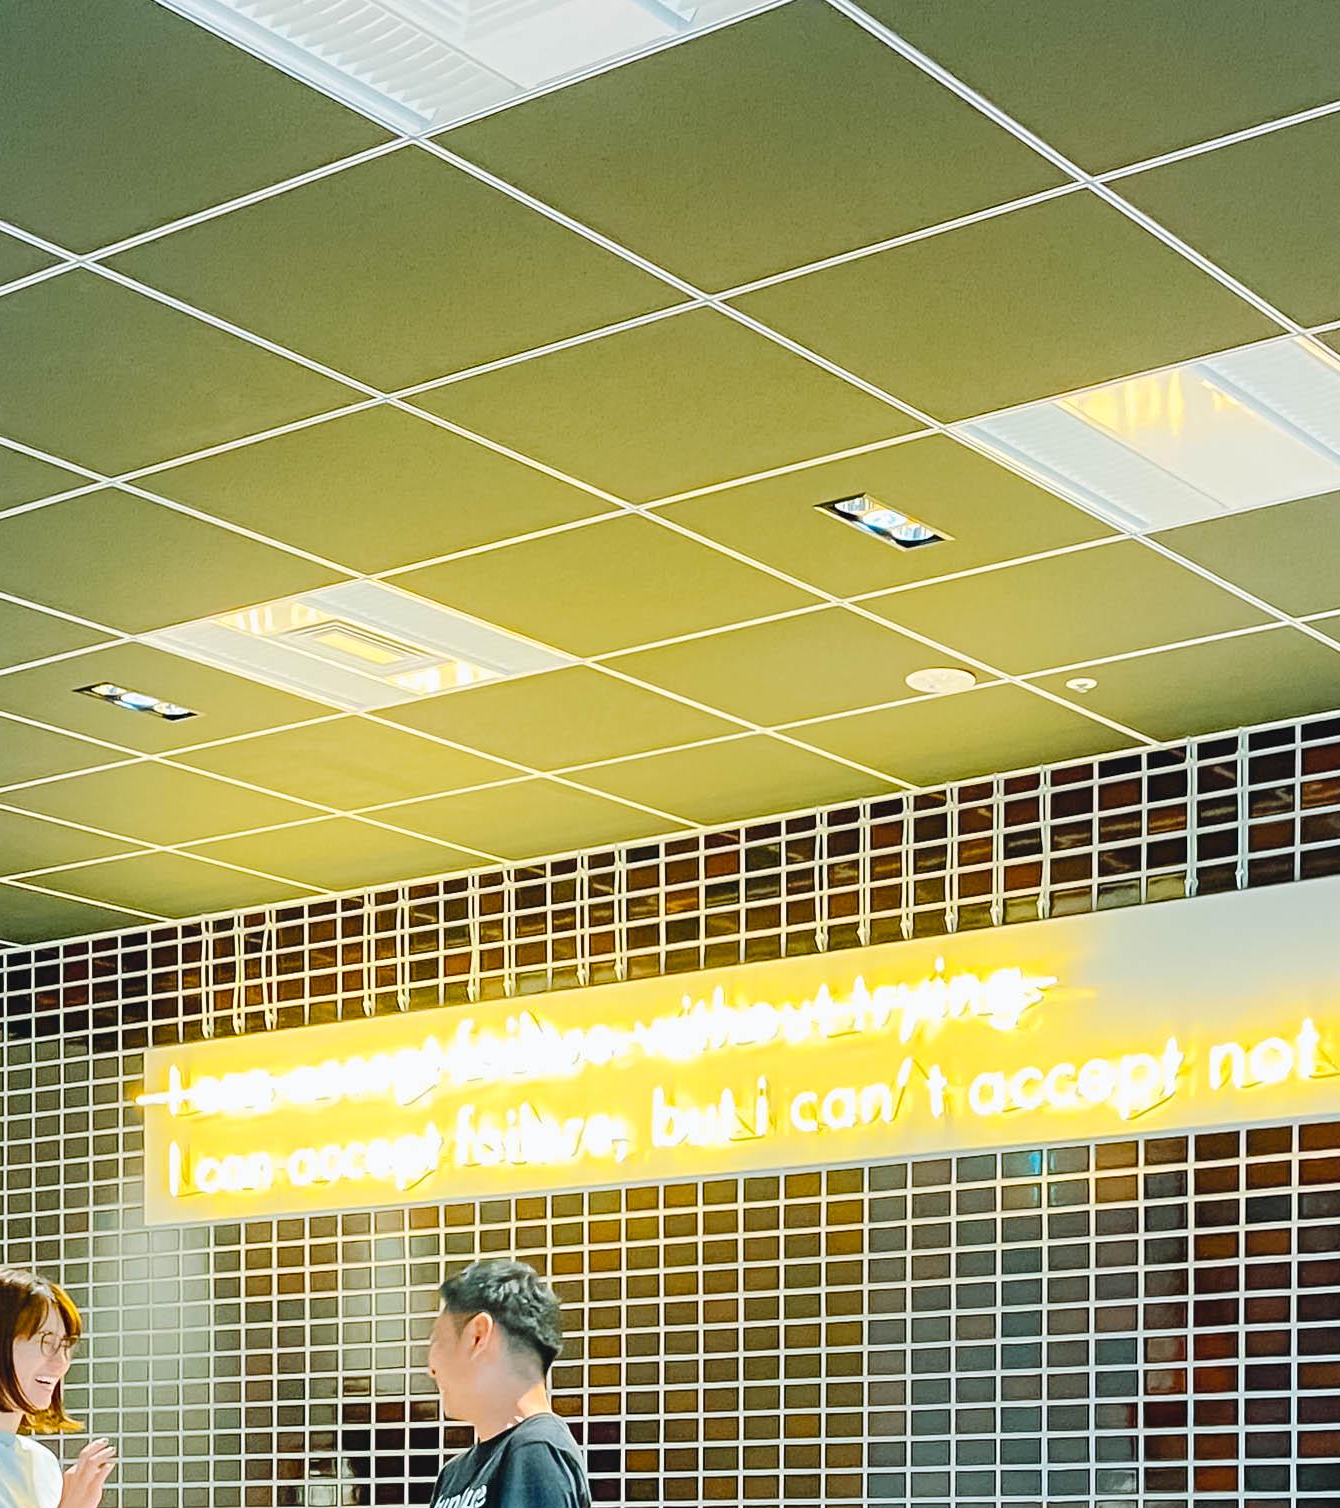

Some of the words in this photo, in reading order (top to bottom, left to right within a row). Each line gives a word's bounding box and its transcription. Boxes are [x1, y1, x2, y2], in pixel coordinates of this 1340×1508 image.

[288, 1121, 443, 1192] accept
[652, 1086, 735, 1148] but
[969, 1035, 1185, 1119] accept
[1209, 1018, 1321, 1090] not
